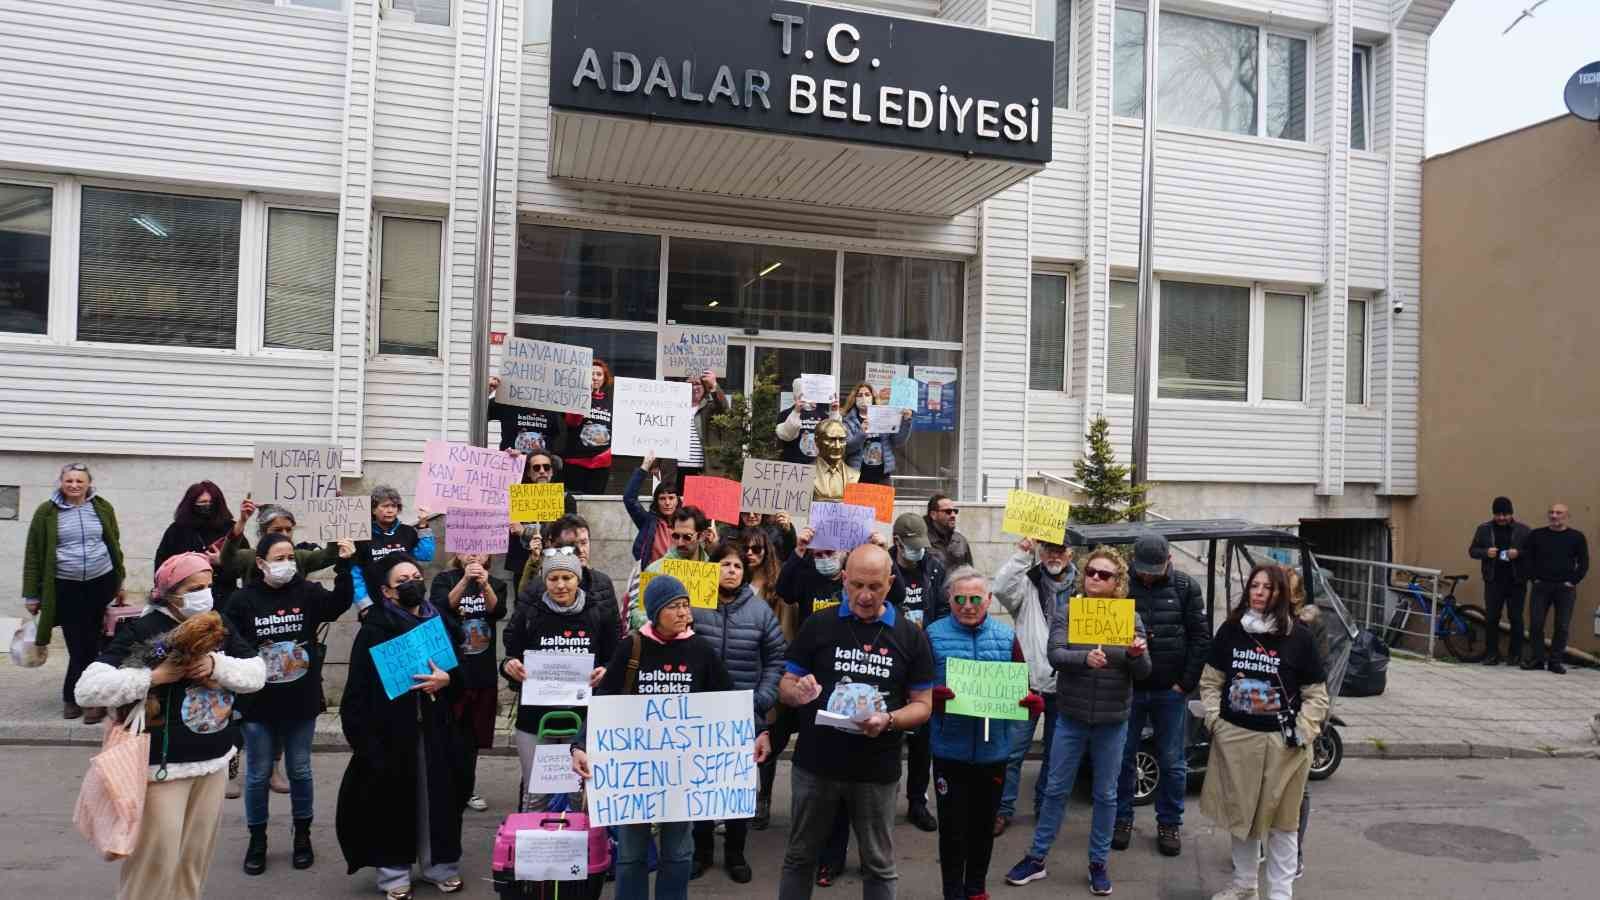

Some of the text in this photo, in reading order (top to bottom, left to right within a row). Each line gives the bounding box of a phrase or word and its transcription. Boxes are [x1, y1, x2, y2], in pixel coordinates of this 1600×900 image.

[572, 47, 1040, 143] ADALAR BELEDİYESİ
[260, 449, 321, 469] MUSTAFA
[427, 462, 457, 482] KAN
[834, 661, 891, 679] sokakta
[1231, 659, 1278, 674] sokakta
[638, 682, 690, 694] sokakta
